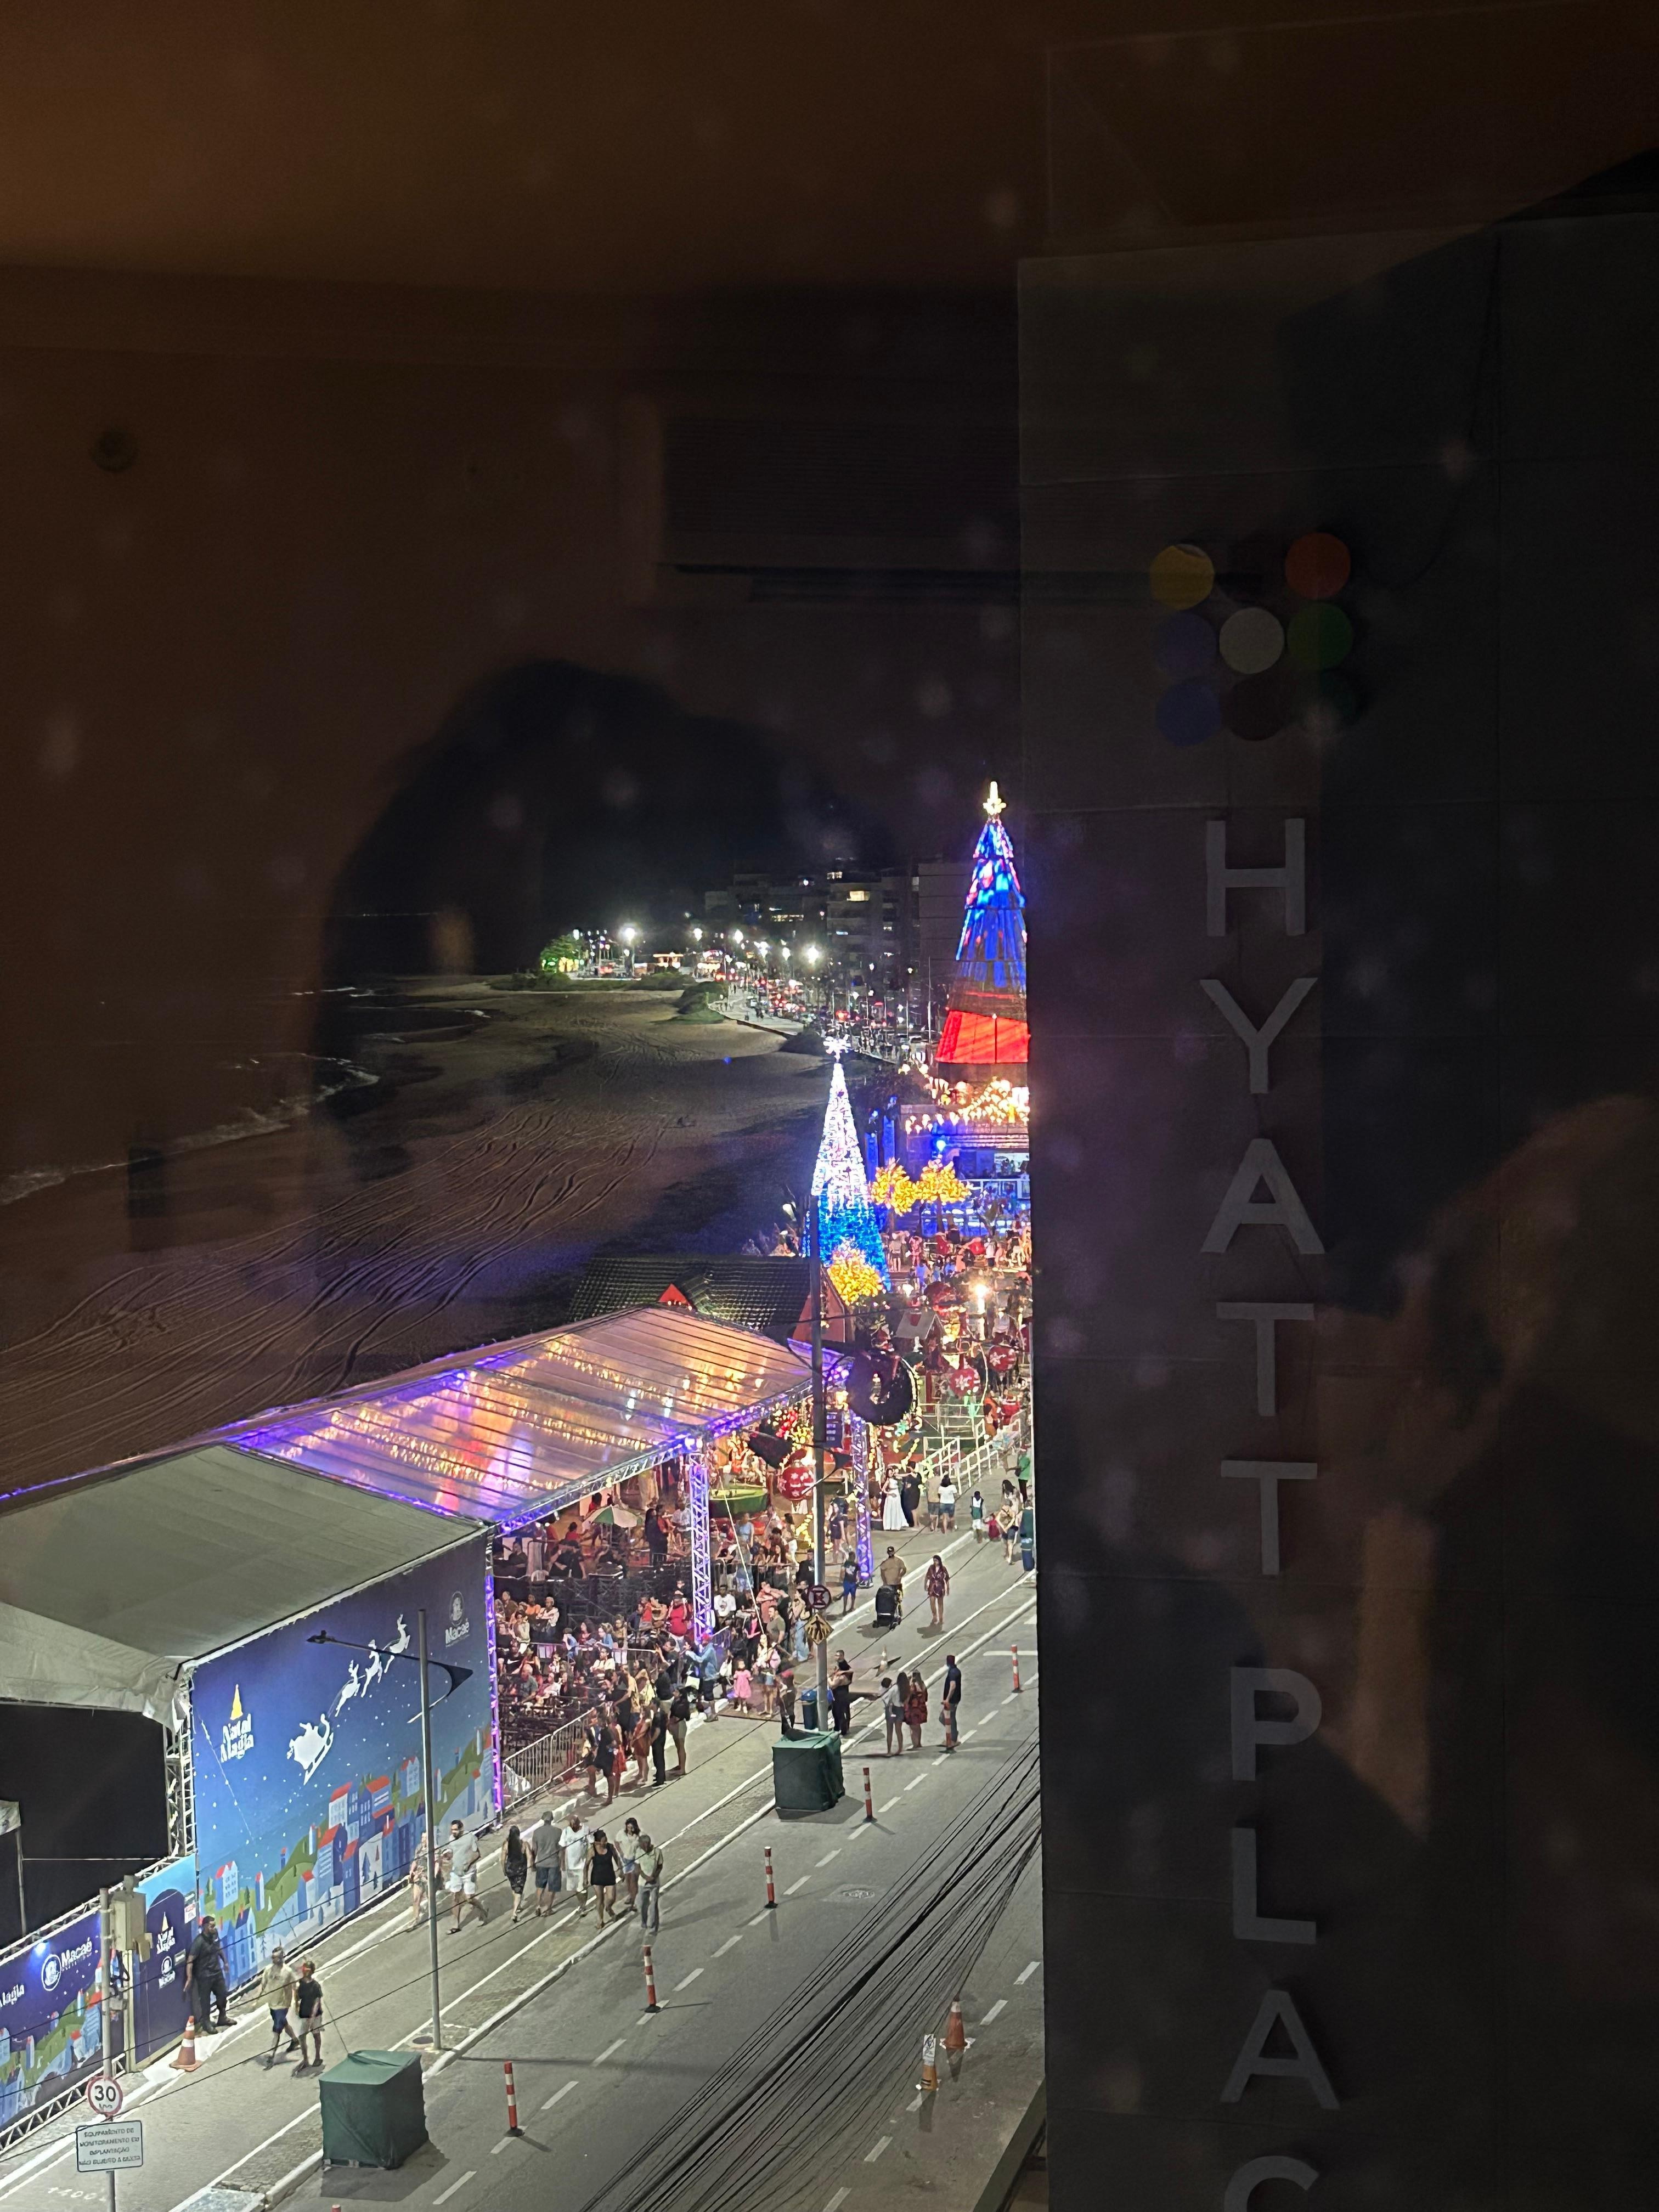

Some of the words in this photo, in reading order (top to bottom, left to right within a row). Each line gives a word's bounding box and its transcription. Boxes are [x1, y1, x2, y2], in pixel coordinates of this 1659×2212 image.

[1199, 817, 1325, 1576] HYATT
[445, 1617, 470, 1644] Macaé
[61, 1937, 93, 1968] Macaé
[94, 2085, 116, 2102] 30
